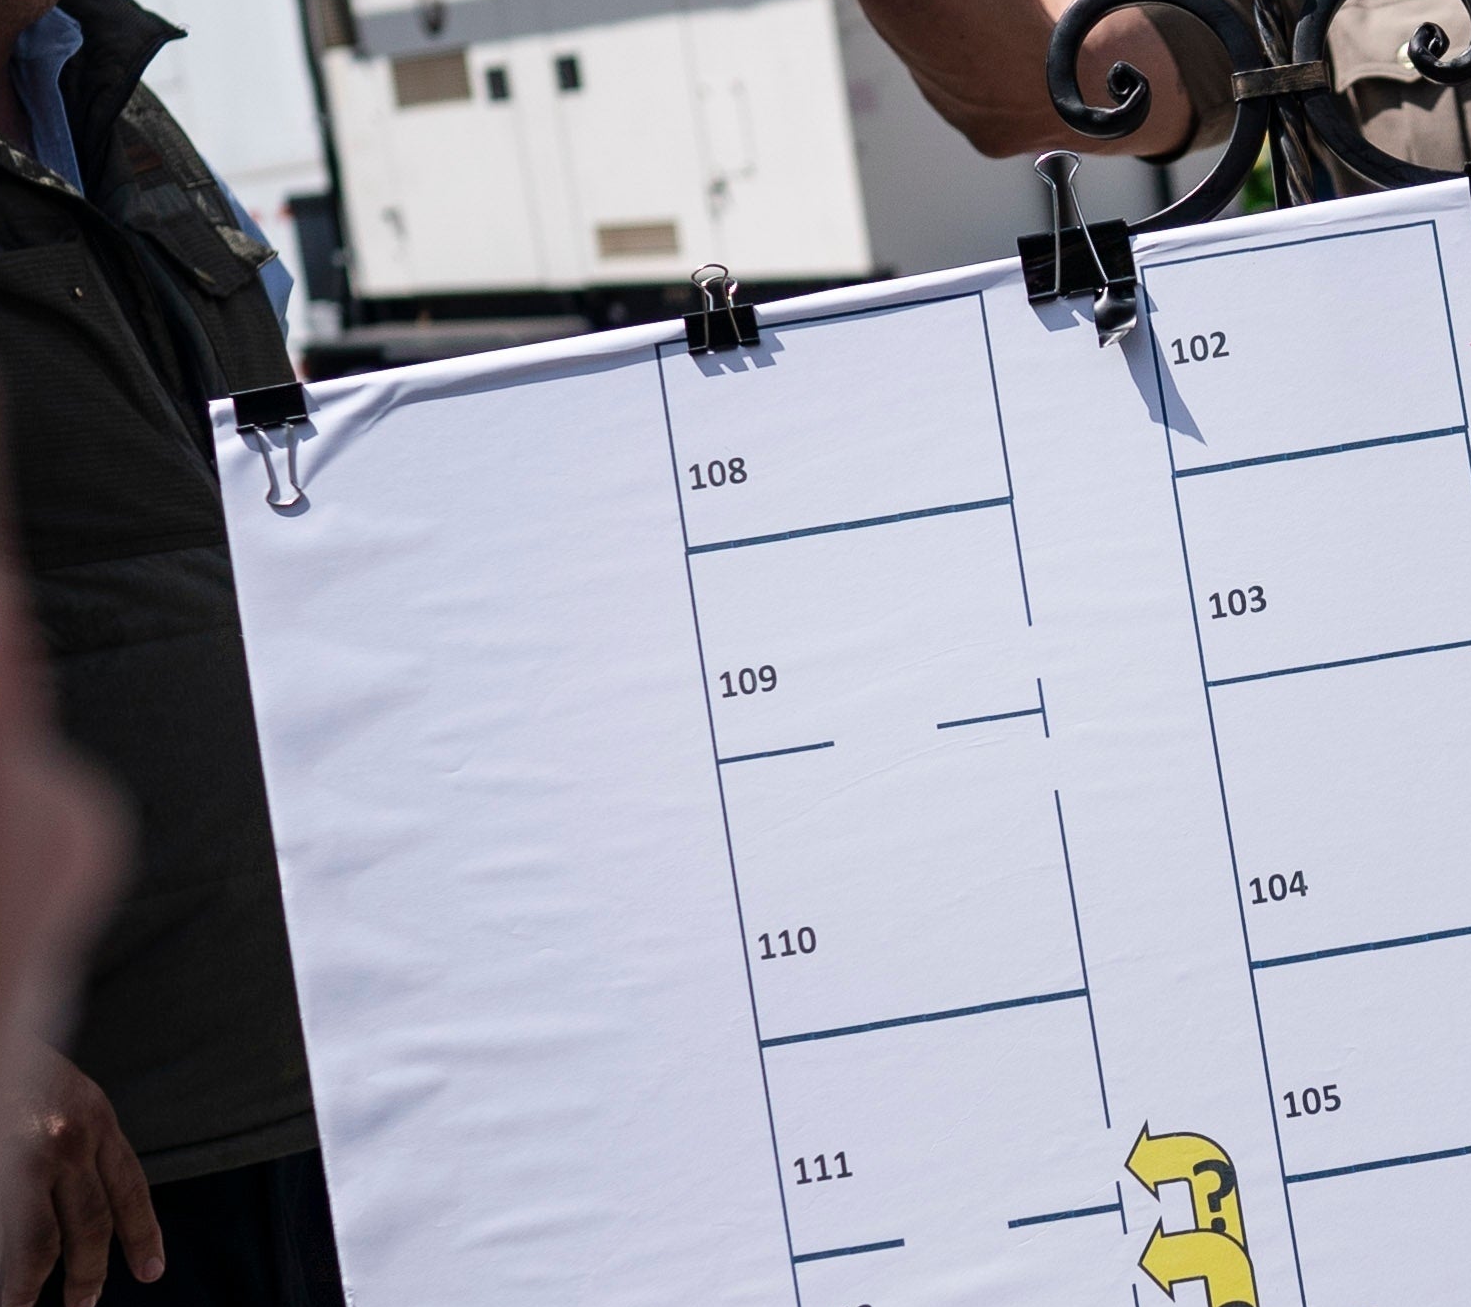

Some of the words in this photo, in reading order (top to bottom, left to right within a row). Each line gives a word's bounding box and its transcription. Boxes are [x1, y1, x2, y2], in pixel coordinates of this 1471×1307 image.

[1172, 332, 1229, 364] 102
[690, 458, 747, 490] 108
[1209, 586, 1266, 619] 103
[720, 665, 776, 698] 109
[1250, 871, 1308, 904] 104
[759, 927, 816, 959] 110
[1284, 1085, 1340, 1118] 105
[794, 1152, 852, 1184] 111
